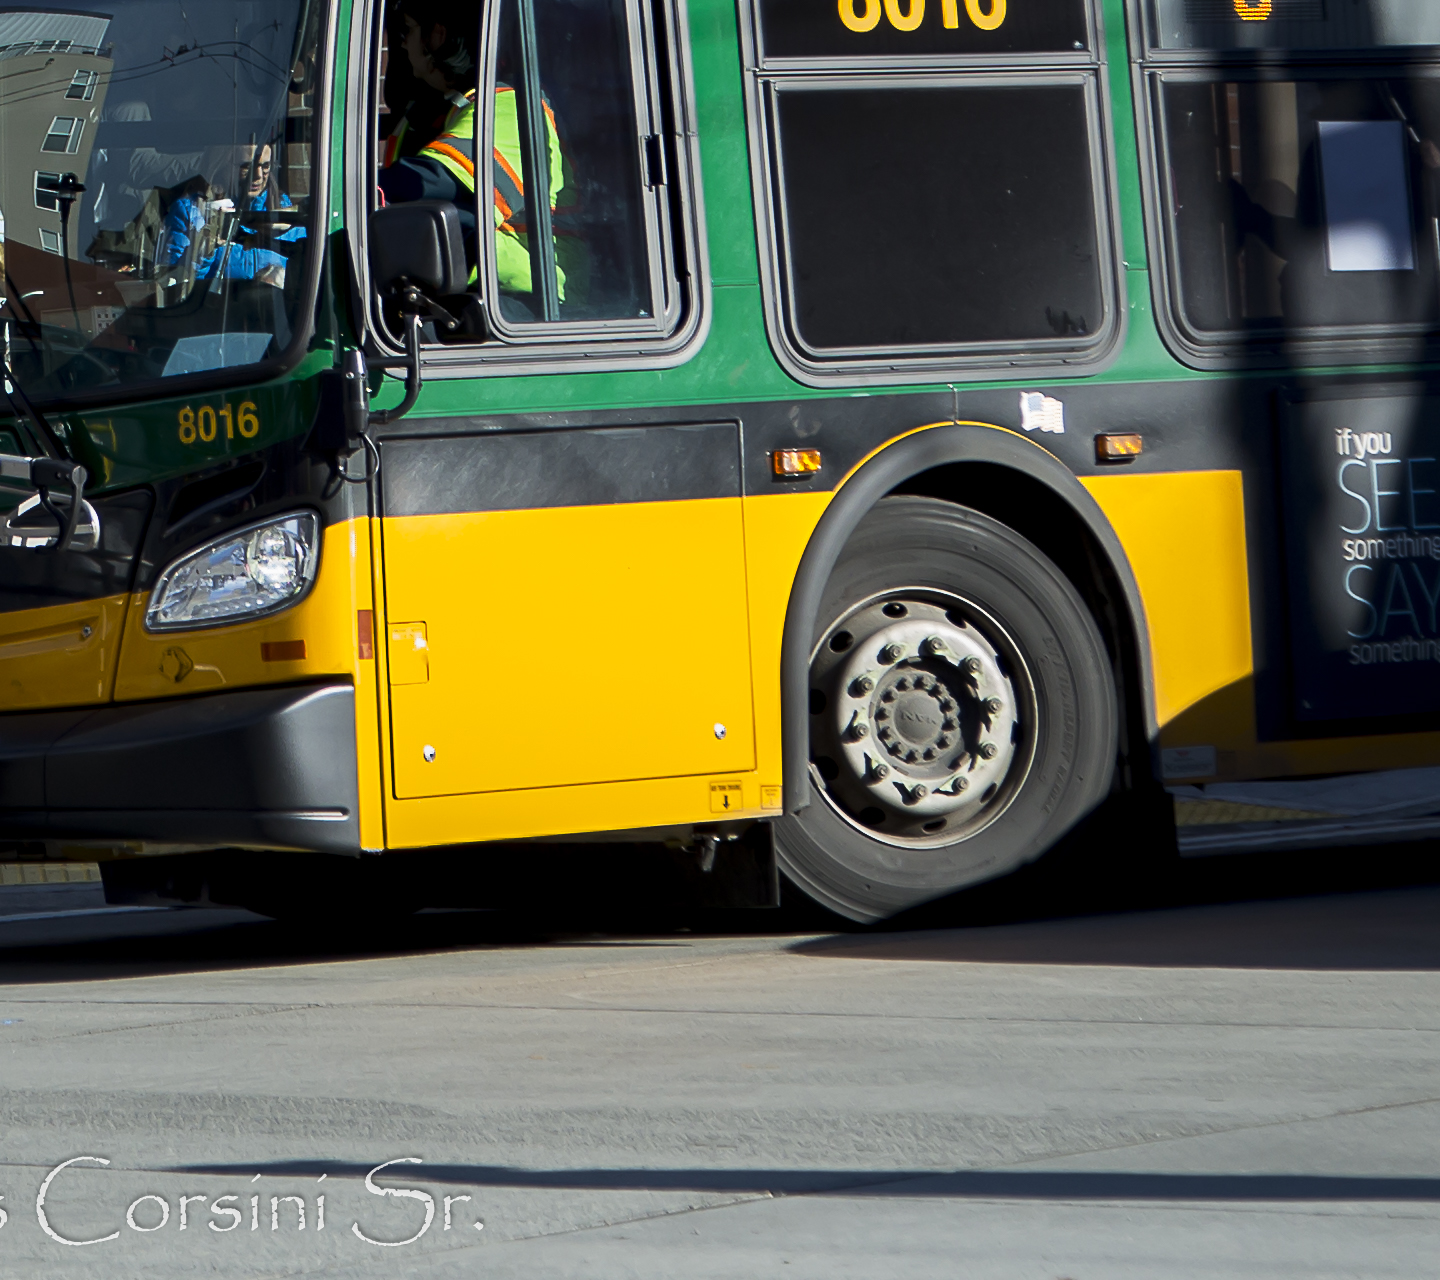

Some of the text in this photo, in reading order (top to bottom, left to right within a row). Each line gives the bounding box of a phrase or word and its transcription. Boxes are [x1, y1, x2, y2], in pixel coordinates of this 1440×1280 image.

[178, 401, 259, 444] 8016
[1335, 428, 1392, 460] if you
